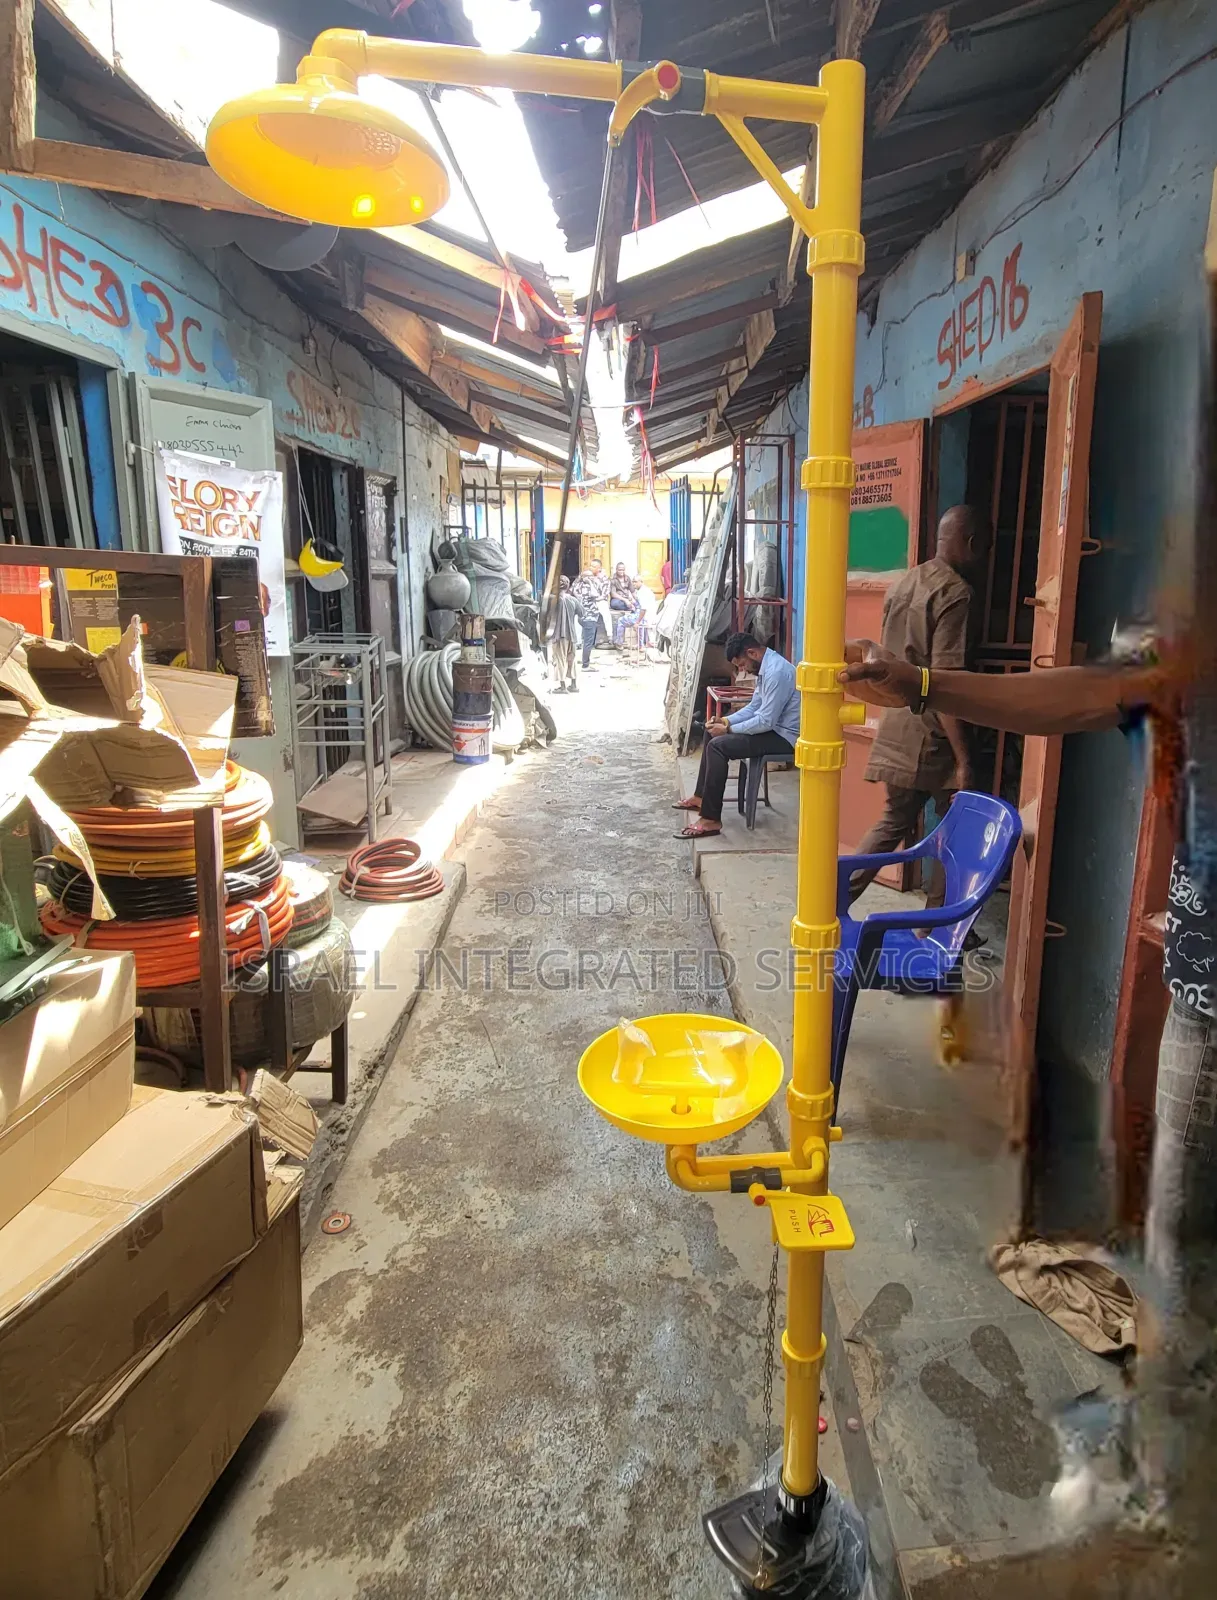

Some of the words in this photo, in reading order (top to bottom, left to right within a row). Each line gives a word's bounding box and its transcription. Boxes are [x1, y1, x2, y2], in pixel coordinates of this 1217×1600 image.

[140, 280, 206, 376] 3C
[937, 276, 997, 391] SHED
[239, 548, 257, 557] 24TH
[789, 1209, 801, 1233] PUSH
